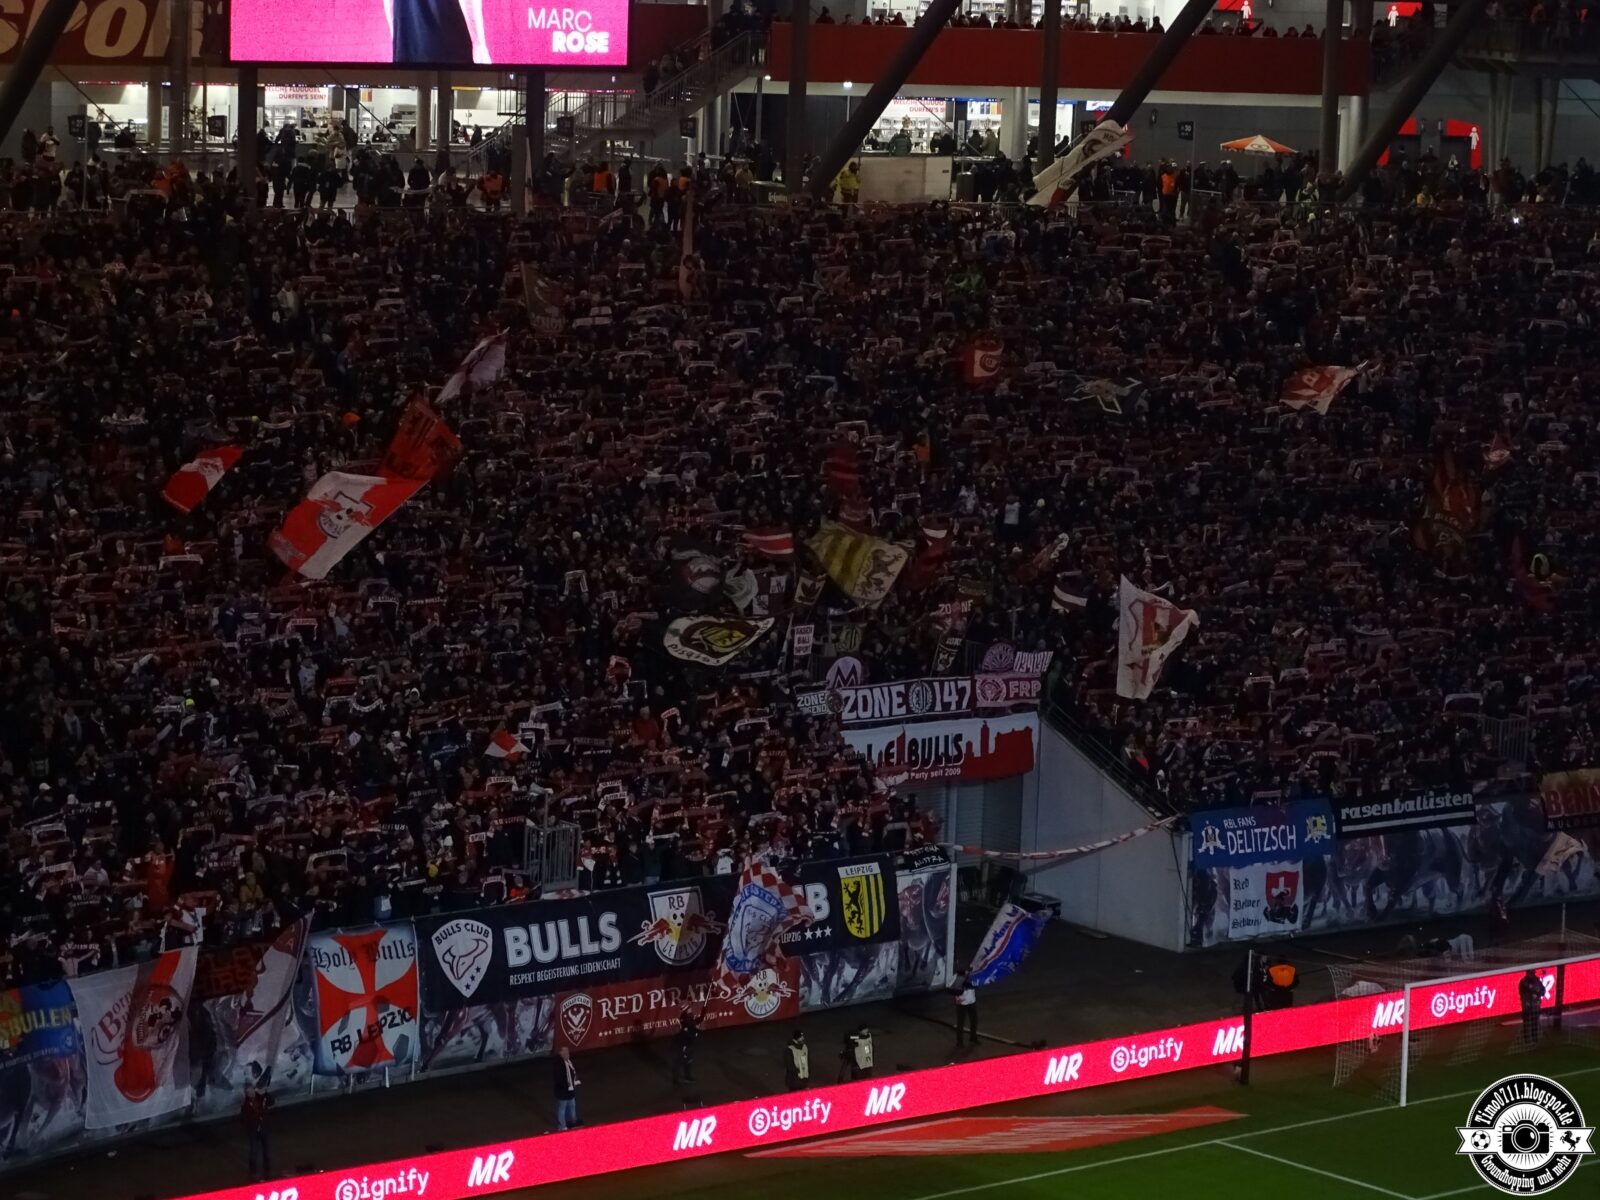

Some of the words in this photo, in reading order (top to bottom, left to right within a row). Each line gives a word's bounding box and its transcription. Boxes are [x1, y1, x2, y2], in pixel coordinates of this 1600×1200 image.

[528, 8, 592, 33] MARC
[552, 31, 609, 54] ROSE
[797, 692, 826, 707] ZONE
[842, 682, 907, 720] ZONE
[933, 680, 972, 712] 147
[1009, 680, 1042, 699] FRP
[908, 733, 963, 769] BULLS
[1341, 789, 1474, 820] rasenballisten
[1223, 818, 1237, 829] RBL
[1238, 815, 1257, 827] FANS
[1227, 824, 1297, 855] DELITZSCH
[846, 865, 873, 876] LEIPZIG
[1233, 878, 1249, 890] Red
[668, 895, 685, 910] RB
[434, 922, 462, 945] BULLS
[464, 922, 490, 939] CLUB
[503, 911, 622, 969] BULLS
[780, 930, 801, 944] LEIPZIG
[509, 973, 535, 986] RESPEKT
[536, 964, 580, 982] BEGEISTERUNG
[597, 993, 644, 1021] RED
[646, 977, 732, 1011] PIRATES
[1371, 997, 1405, 1029] MR
[1044, 1052, 1083, 1085] MR
[864, 1082, 906, 1117] MR
[672, 1115, 717, 1151] MR
[467, 1149, 515, 1188] MR
